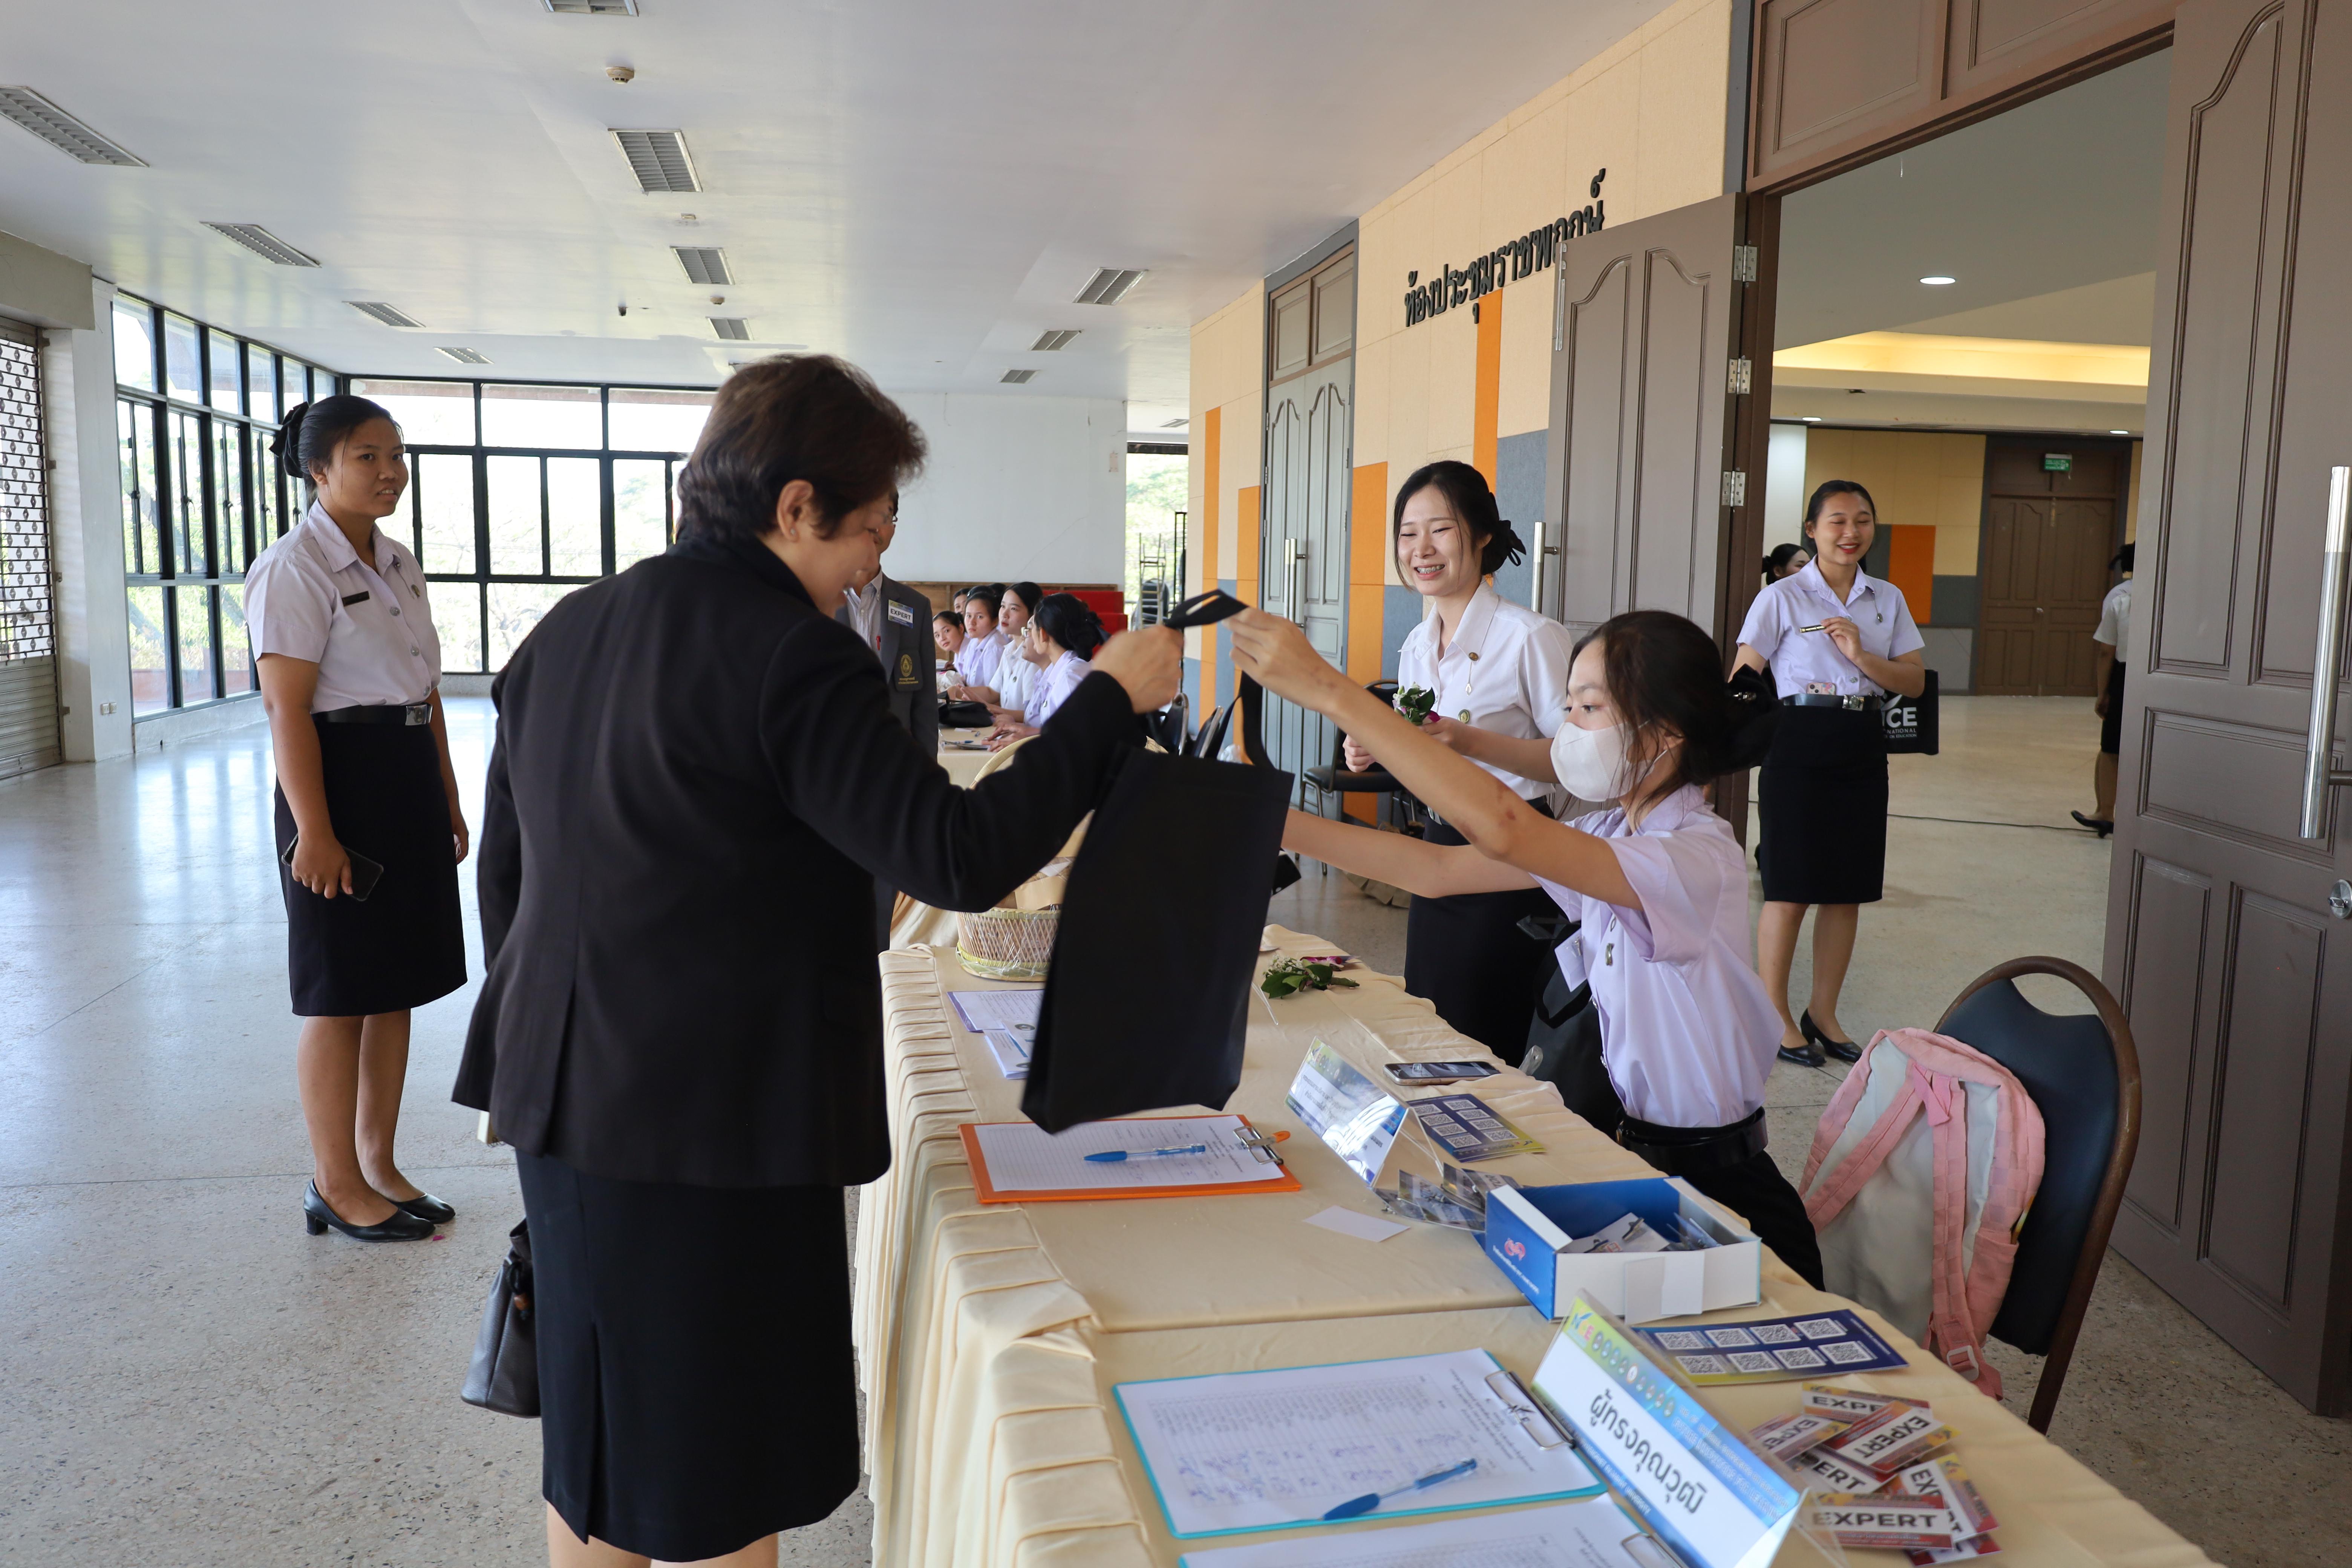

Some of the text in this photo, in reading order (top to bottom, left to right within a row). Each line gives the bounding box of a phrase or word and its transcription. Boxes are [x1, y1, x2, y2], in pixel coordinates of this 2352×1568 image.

[891, 608, 911, 620] EXPERT
[1590, 1388, 1709, 1513] ผู้ทรงคุณวุฒิ
[1854, 1415, 1932, 1458] EXPERT
[1812, 1512, 1937, 1528] EXPERT
